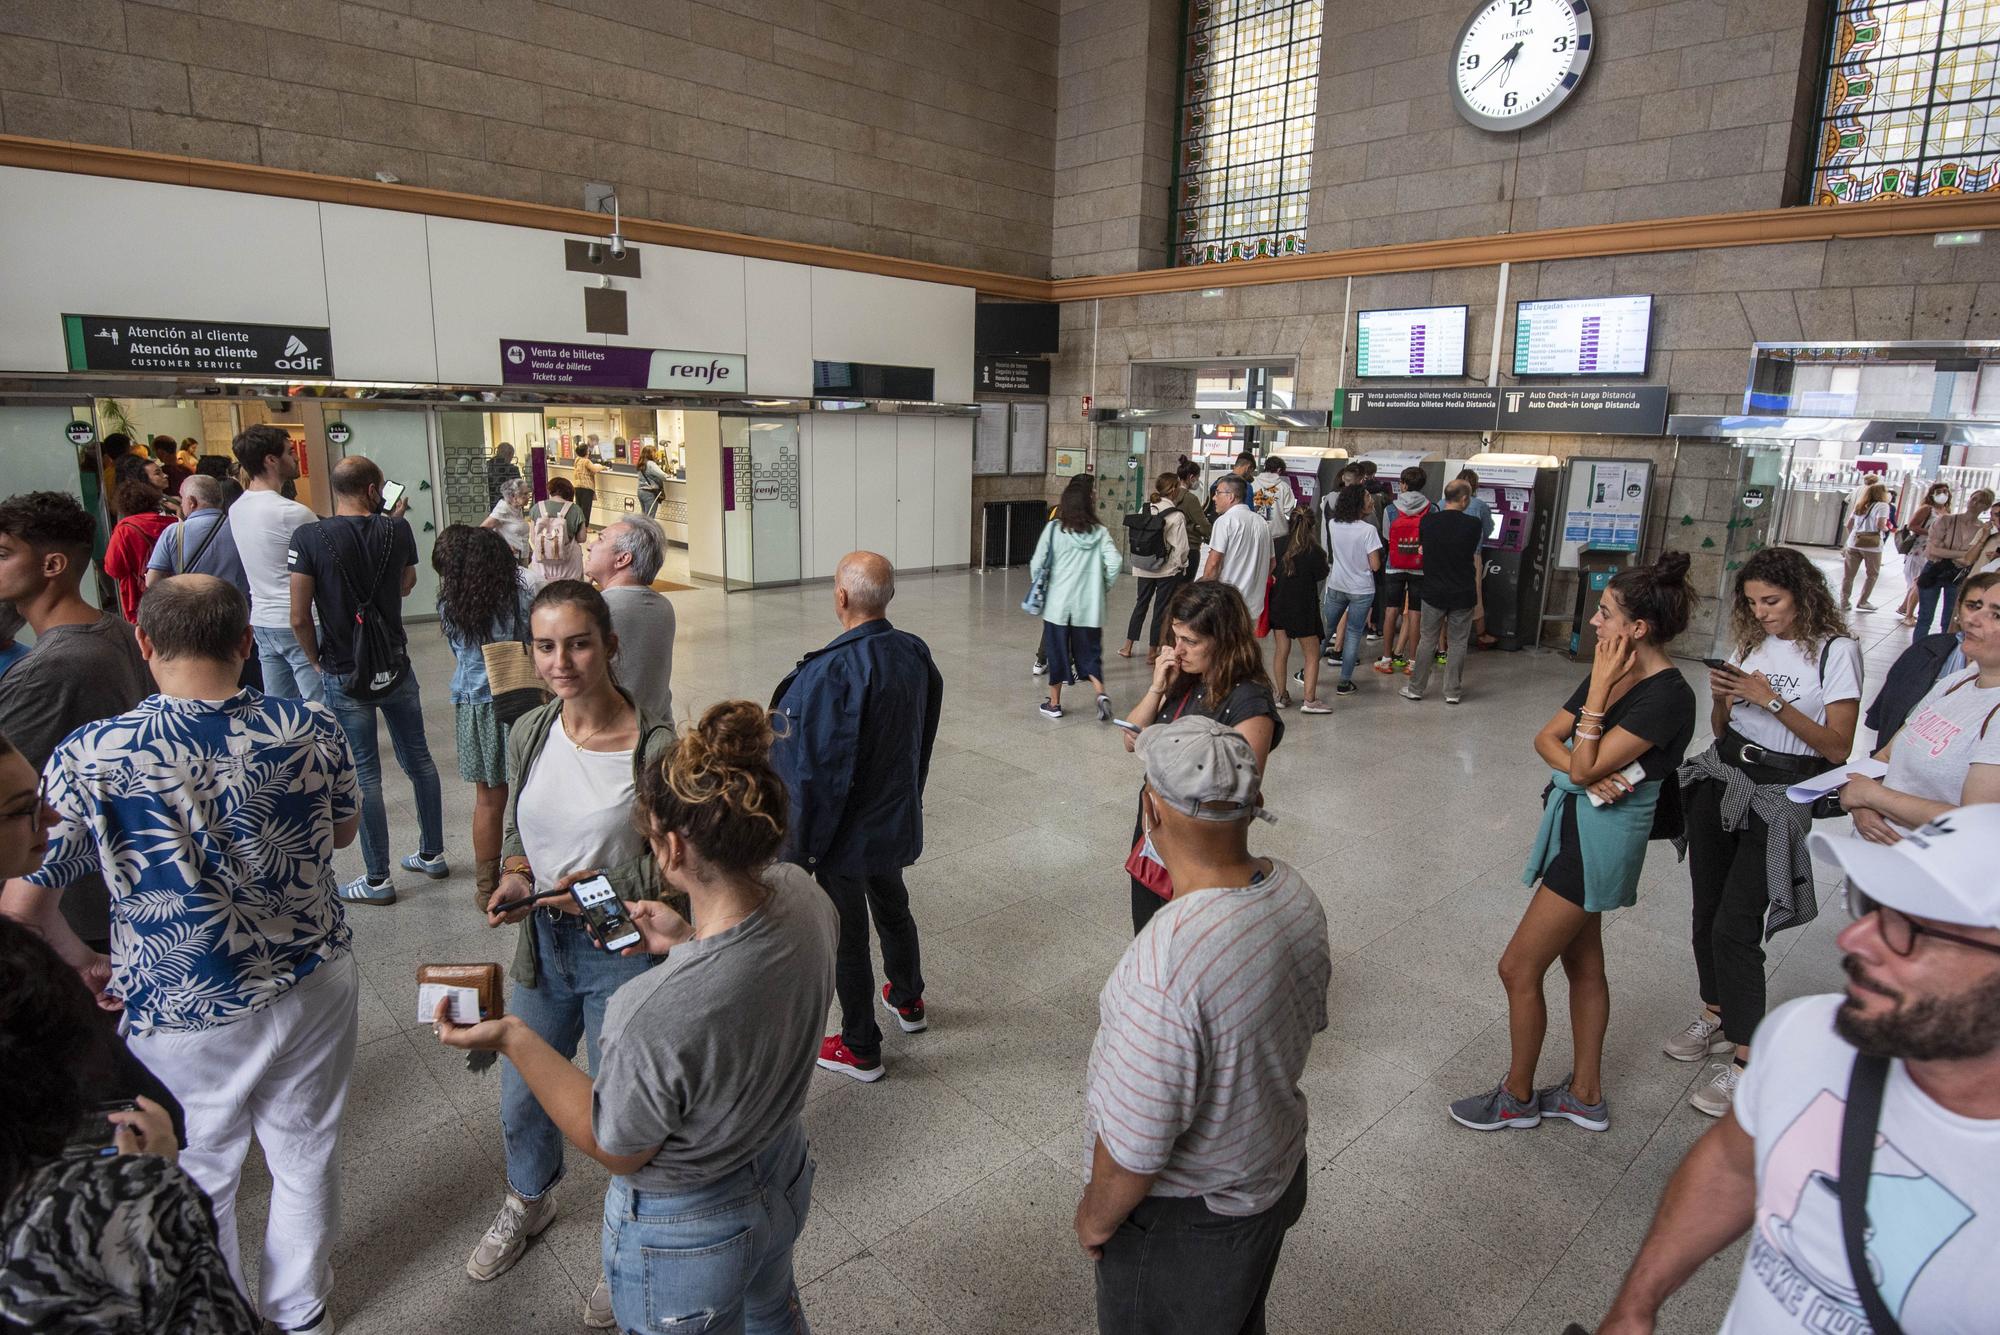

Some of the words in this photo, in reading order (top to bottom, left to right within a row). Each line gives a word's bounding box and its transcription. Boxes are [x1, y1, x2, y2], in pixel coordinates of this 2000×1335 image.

[1509, 0, 1532, 16] 12
[1502, 28, 1534, 40] FESTINA
[1552, 36, 1568, 52] 3
[1466, 54, 1480, 70] 9
[1504, 92, 1518, 108] 6
[128, 326, 186, 340] Atención
[192, 329, 202, 340] al
[206, 330, 249, 342] cliente
[130, 343, 189, 356] Atención
[194, 348, 210, 356] ao
[214, 346, 258, 358] cliente
[531, 347, 557, 357] Venta
[560, 349, 571, 358] de
[573, 350, 605, 360] billetes
[131, 358, 190, 368] CUSTOMER
[197, 360, 242, 369] SERVICE
[275, 356, 323, 370] adif
[531, 361, 554, 369] Venda
[556, 362, 564, 370] de
[566, 362, 592, 371] billetes
[532, 372, 556, 382] Tickets
[558, 374, 573, 382] sale
[670, 360, 730, 384] renfe
[1581, 392, 1600, 400] Larga
[1581, 401, 1602, 410] Longa
[756, 486, 779, 495] renfe
